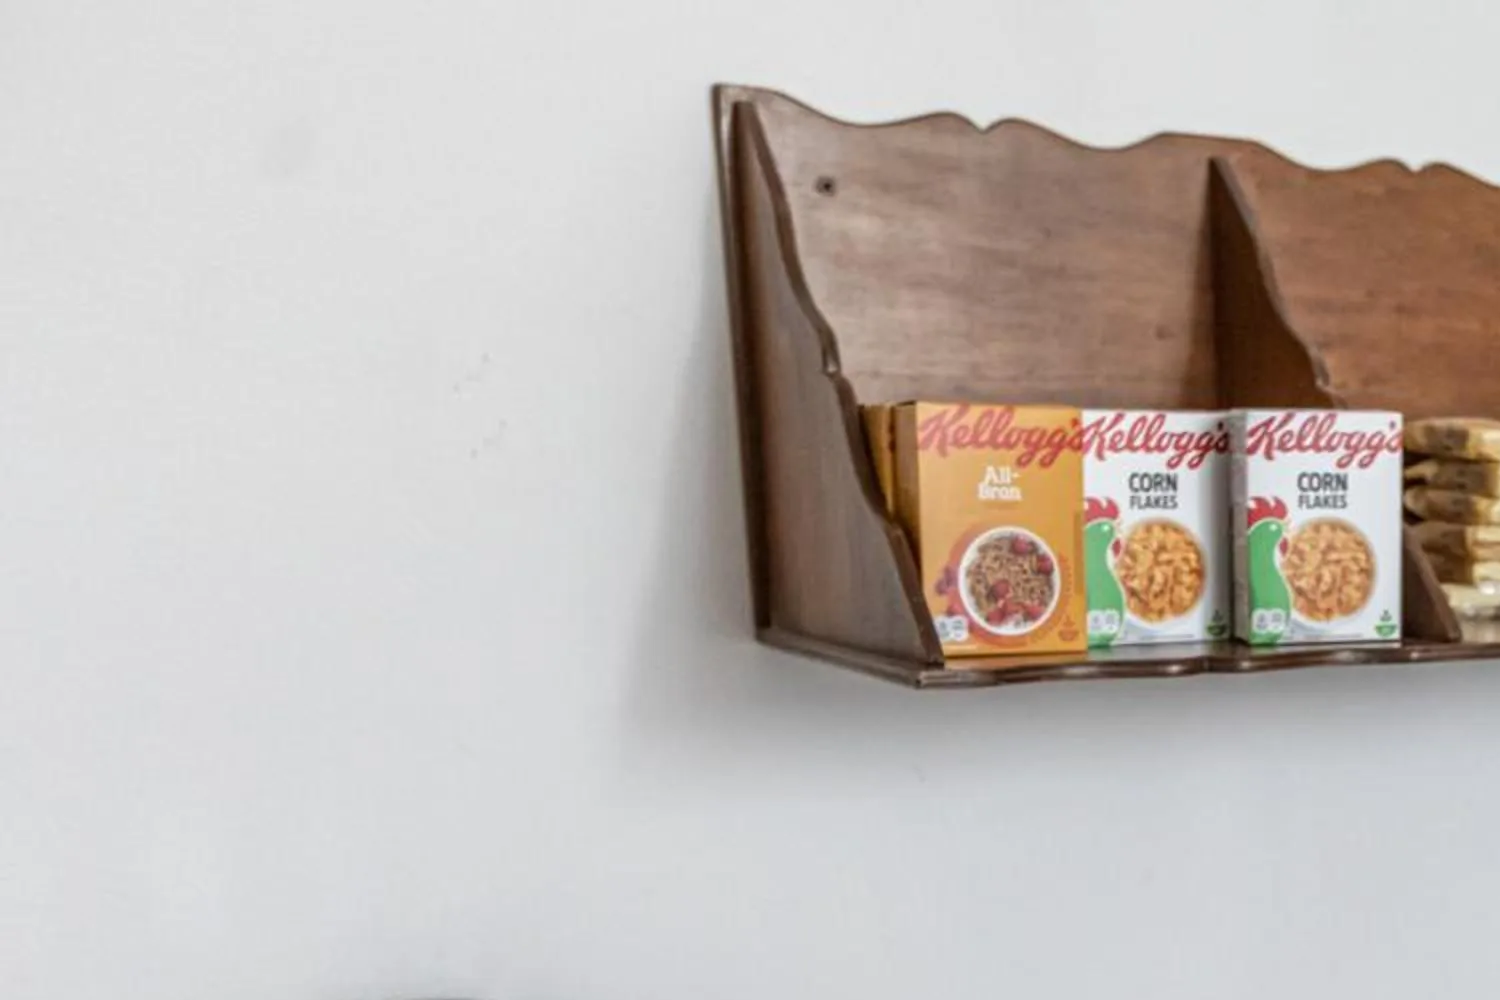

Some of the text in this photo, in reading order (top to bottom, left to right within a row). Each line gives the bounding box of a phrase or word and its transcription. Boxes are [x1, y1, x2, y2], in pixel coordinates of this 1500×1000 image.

[918, 403, 1083, 468] Kellogg's
[1083, 412, 1230, 470] Kellogg's
[1246, 412, 1403, 469] Kellogg's
[1128, 472, 1178, 493] CORN
[1297, 472, 1348, 492] CORN
[1129, 495, 1178, 510] FLAKES
[1298, 495, 1347, 510] FLAKES
